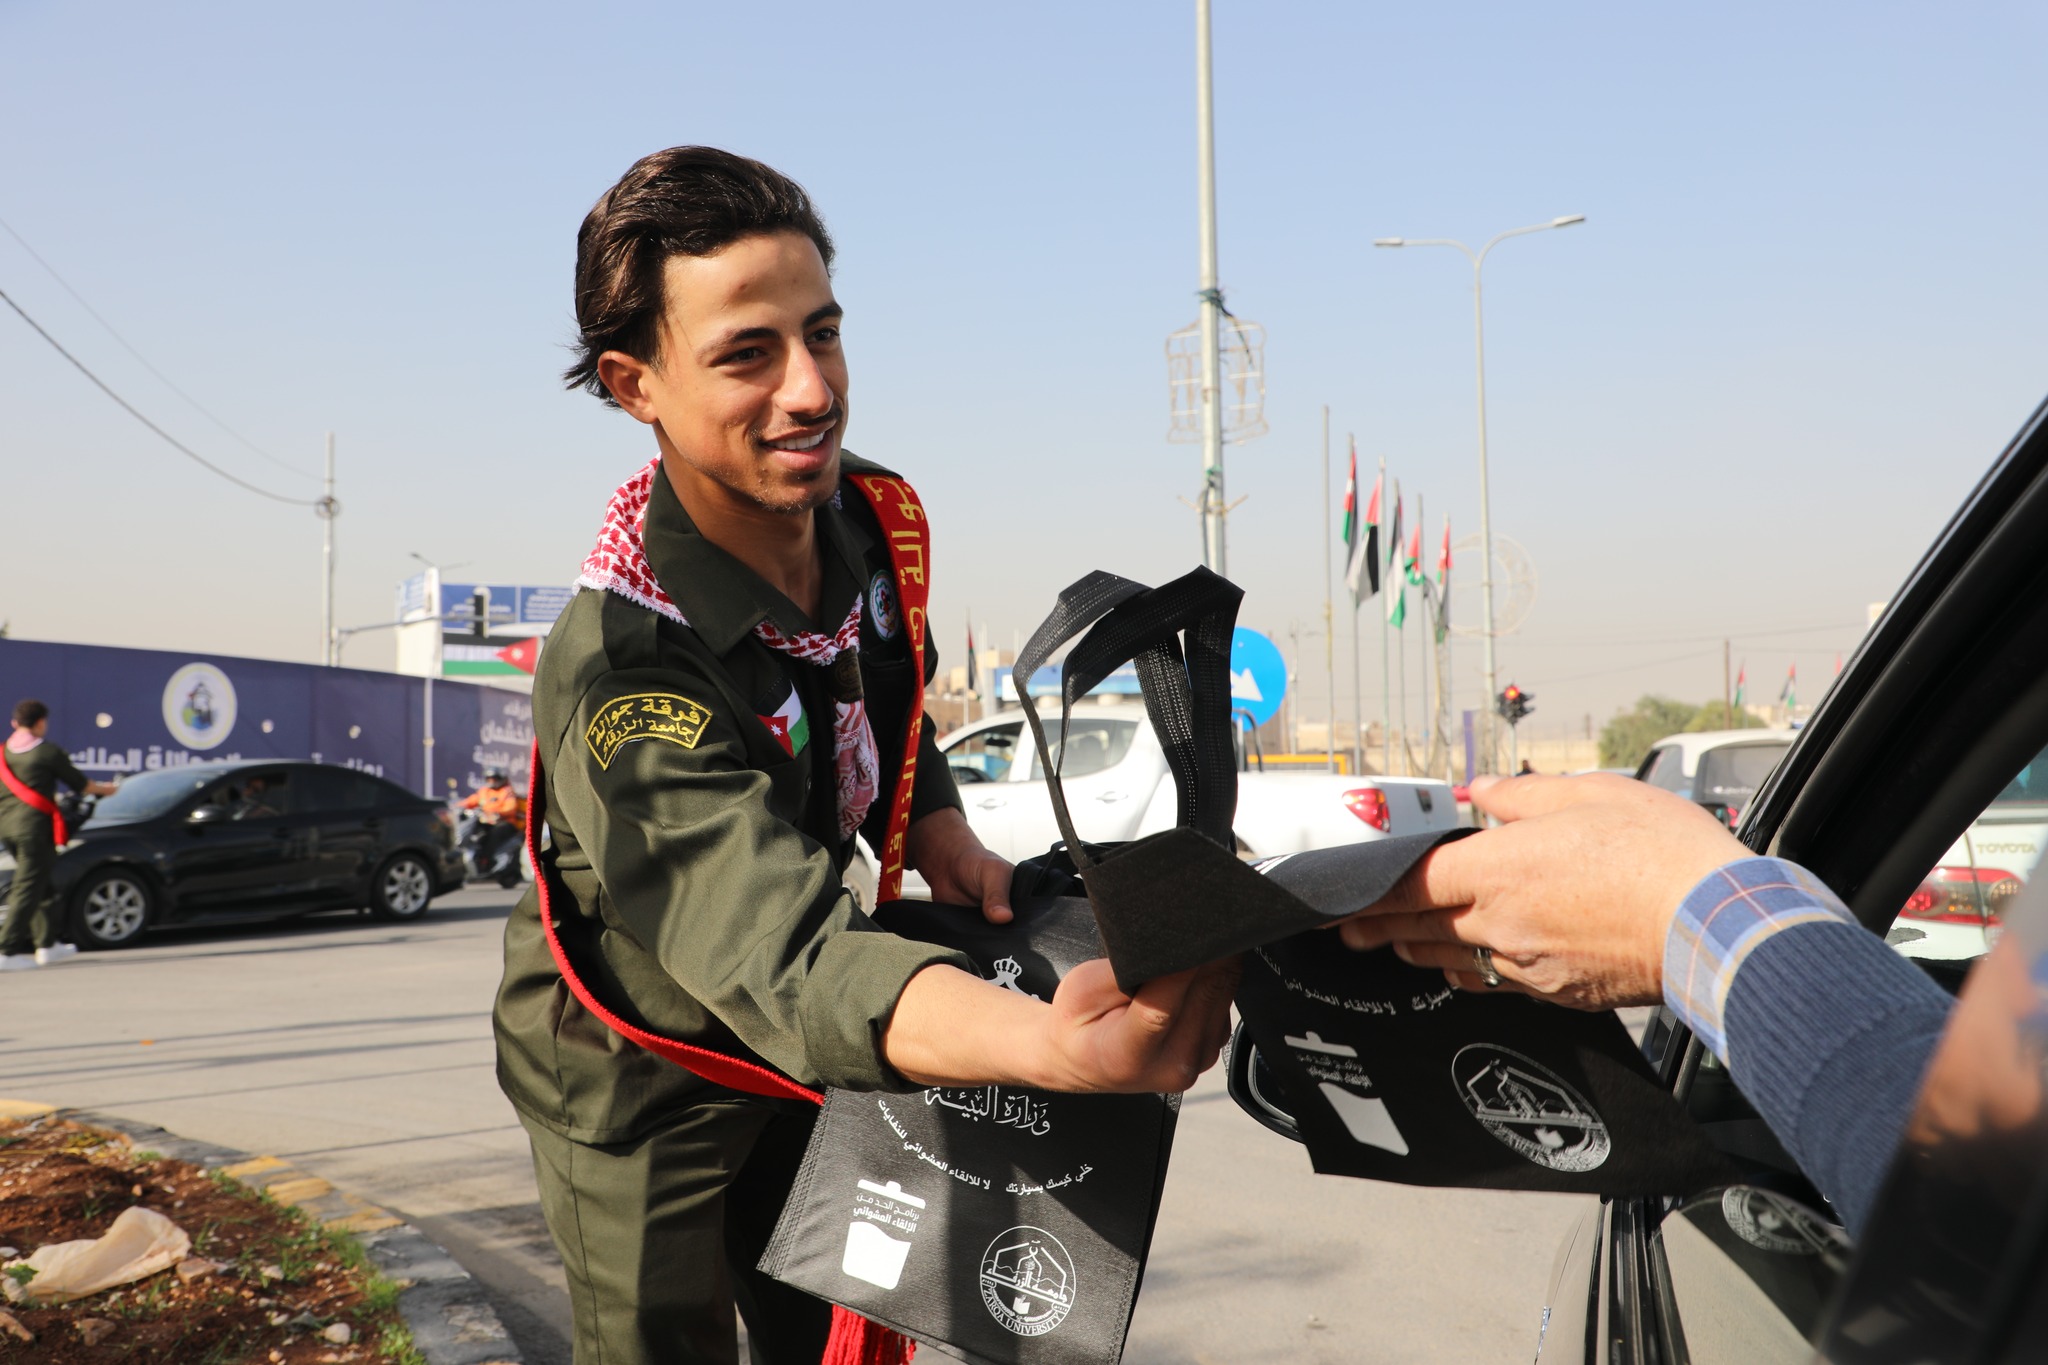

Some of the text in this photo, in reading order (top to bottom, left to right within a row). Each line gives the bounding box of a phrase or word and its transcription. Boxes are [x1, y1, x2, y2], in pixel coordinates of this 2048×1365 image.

[864, 476, 925, 587] جوالة
[590, 698, 700, 746] فرقة جوالة
[603, 717, 694, 760] جامعة الزرقاء
[69, 746, 142, 772] الملك
[886, 757, 916, 900] الزرقاء
[1976, 843, 2037, 854] TOYOTA
[878, 1099, 908, 1139] للنفايات
[903, 1141, 948, 1172] العشوائي
[983, 1179, 991, 1190] لا
[1005, 1163, 1094, 1196] خلي كيسك بسيارتك
[853, 1206, 892, 1224] العشوائي
[856, 1193, 920, 1221] برنامج الحد من
[983, 1289, 1061, 1334] ZARQA UNIVERSITY
